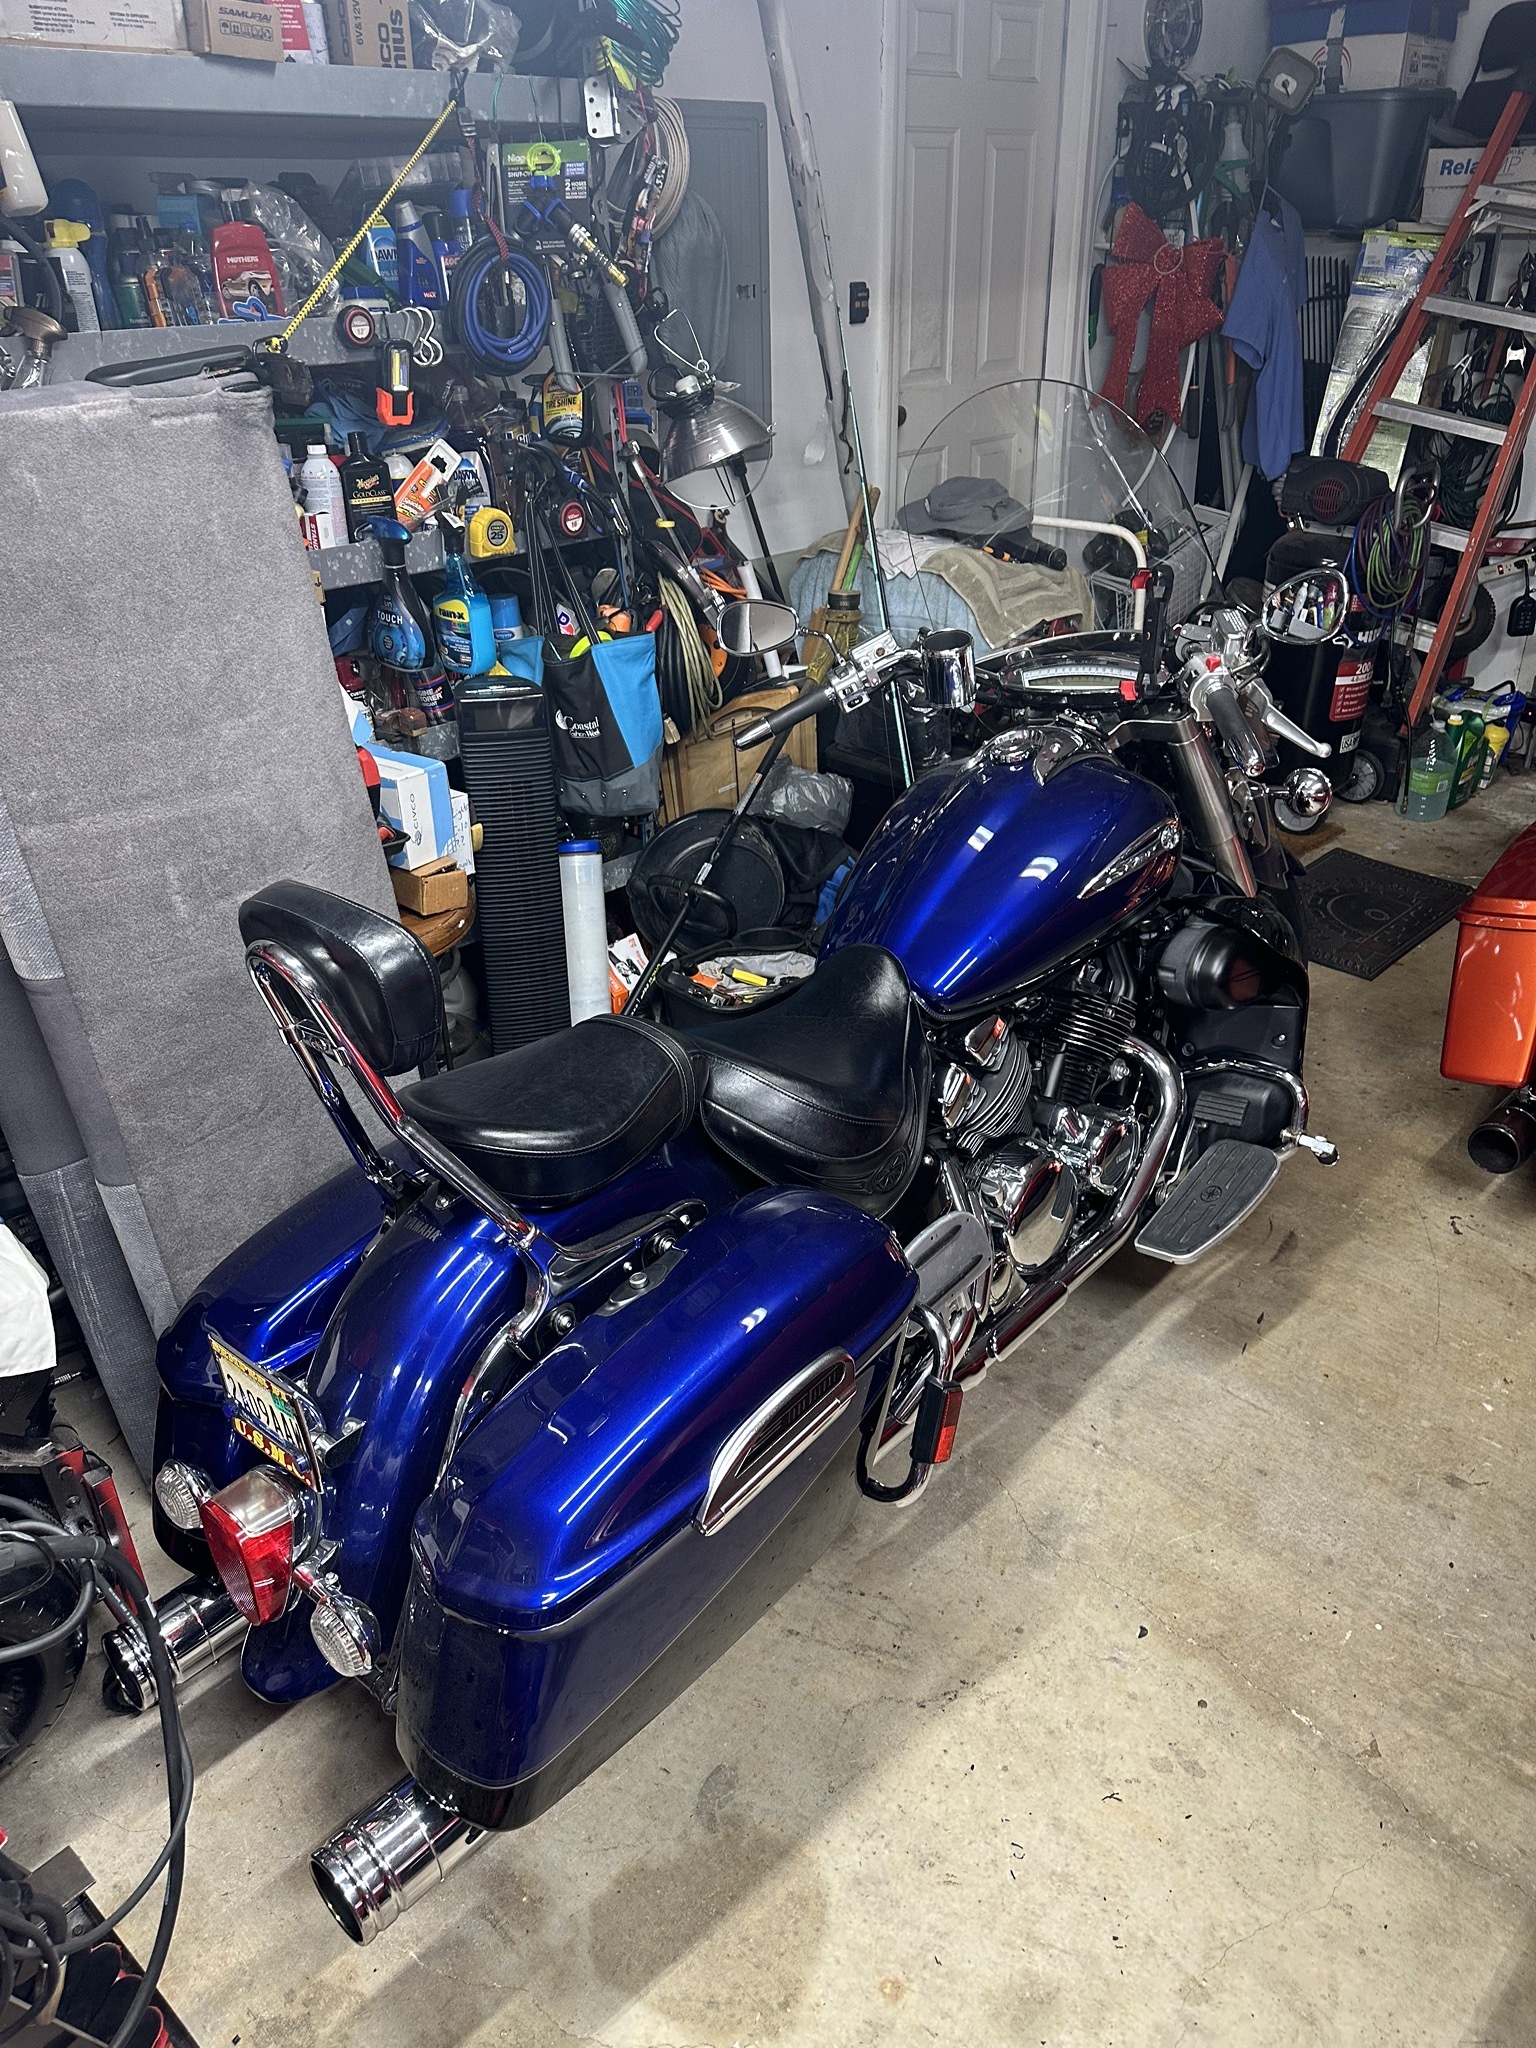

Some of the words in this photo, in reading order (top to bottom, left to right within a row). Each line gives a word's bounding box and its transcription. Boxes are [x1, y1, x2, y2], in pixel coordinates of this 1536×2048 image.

[218, 6, 272, 23] SAMURAI
[564, 182, 571, 191] 2
[226, 255, 259, 264] MOTHERS
[546, 399, 556, 410] TIRE
[556, 396, 577, 408] SHINE
[490, 531, 504, 540] 25
[377, 610, 403, 625] TOUCH
[1355, 661, 1372, 675] 200
[563, 715, 600, 730] Coastal
[409, 793, 419, 829] CIVCO
[404, 1216, 441, 1242] YAMAHA
